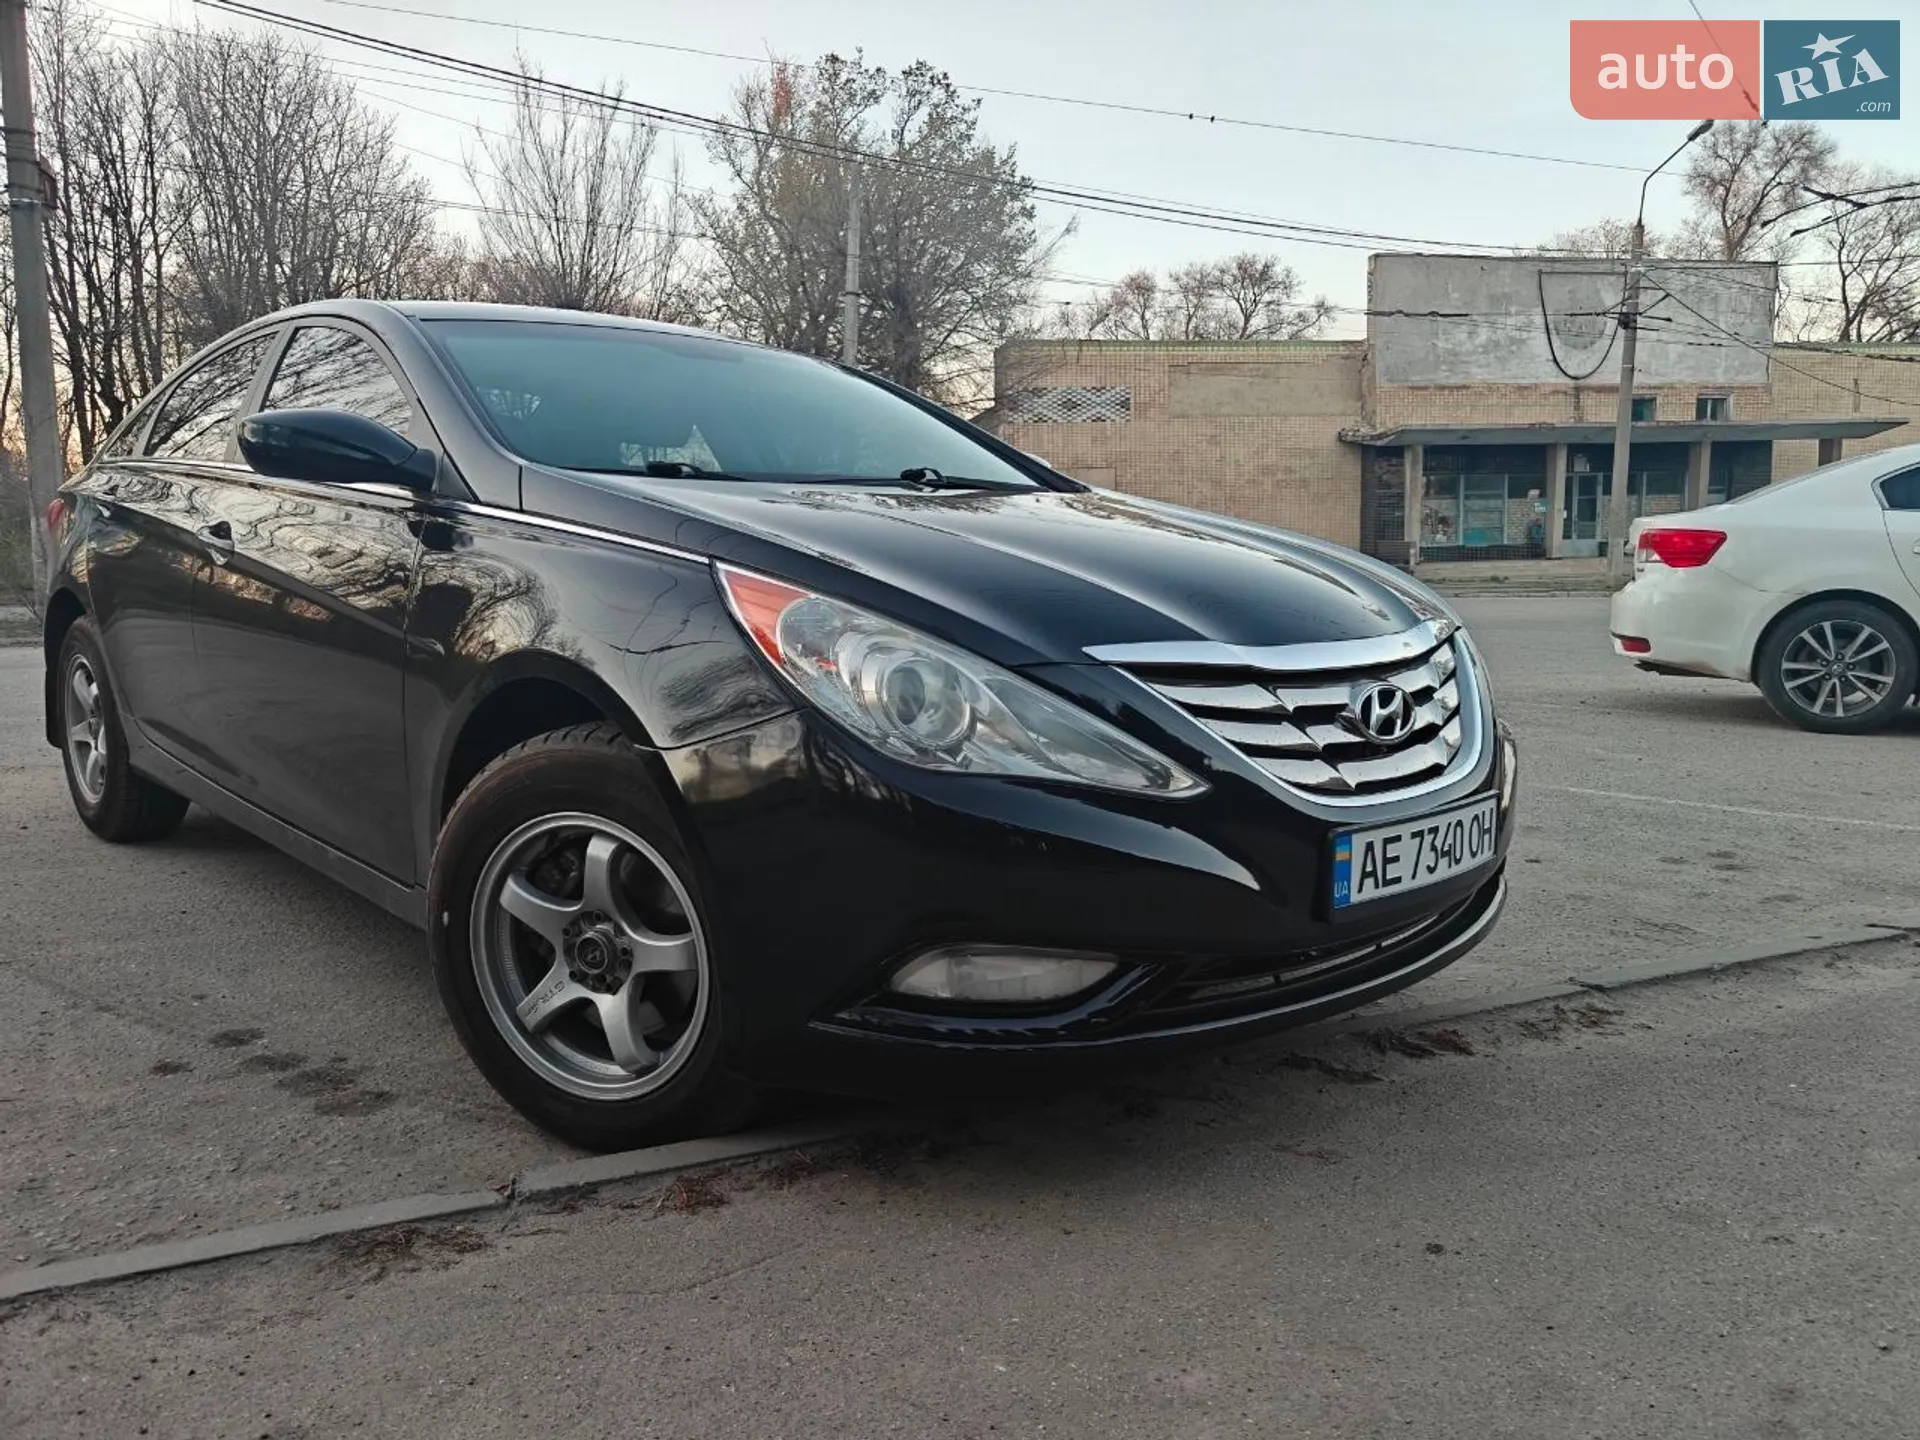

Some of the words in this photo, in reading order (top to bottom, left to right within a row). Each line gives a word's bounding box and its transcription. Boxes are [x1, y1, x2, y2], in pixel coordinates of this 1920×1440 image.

[1357, 834, 1402, 894] AE
[1410, 819, 1464, 880] 7340
[1469, 807, 1494, 859] OH
[1334, 881, 1349, 898] UA
